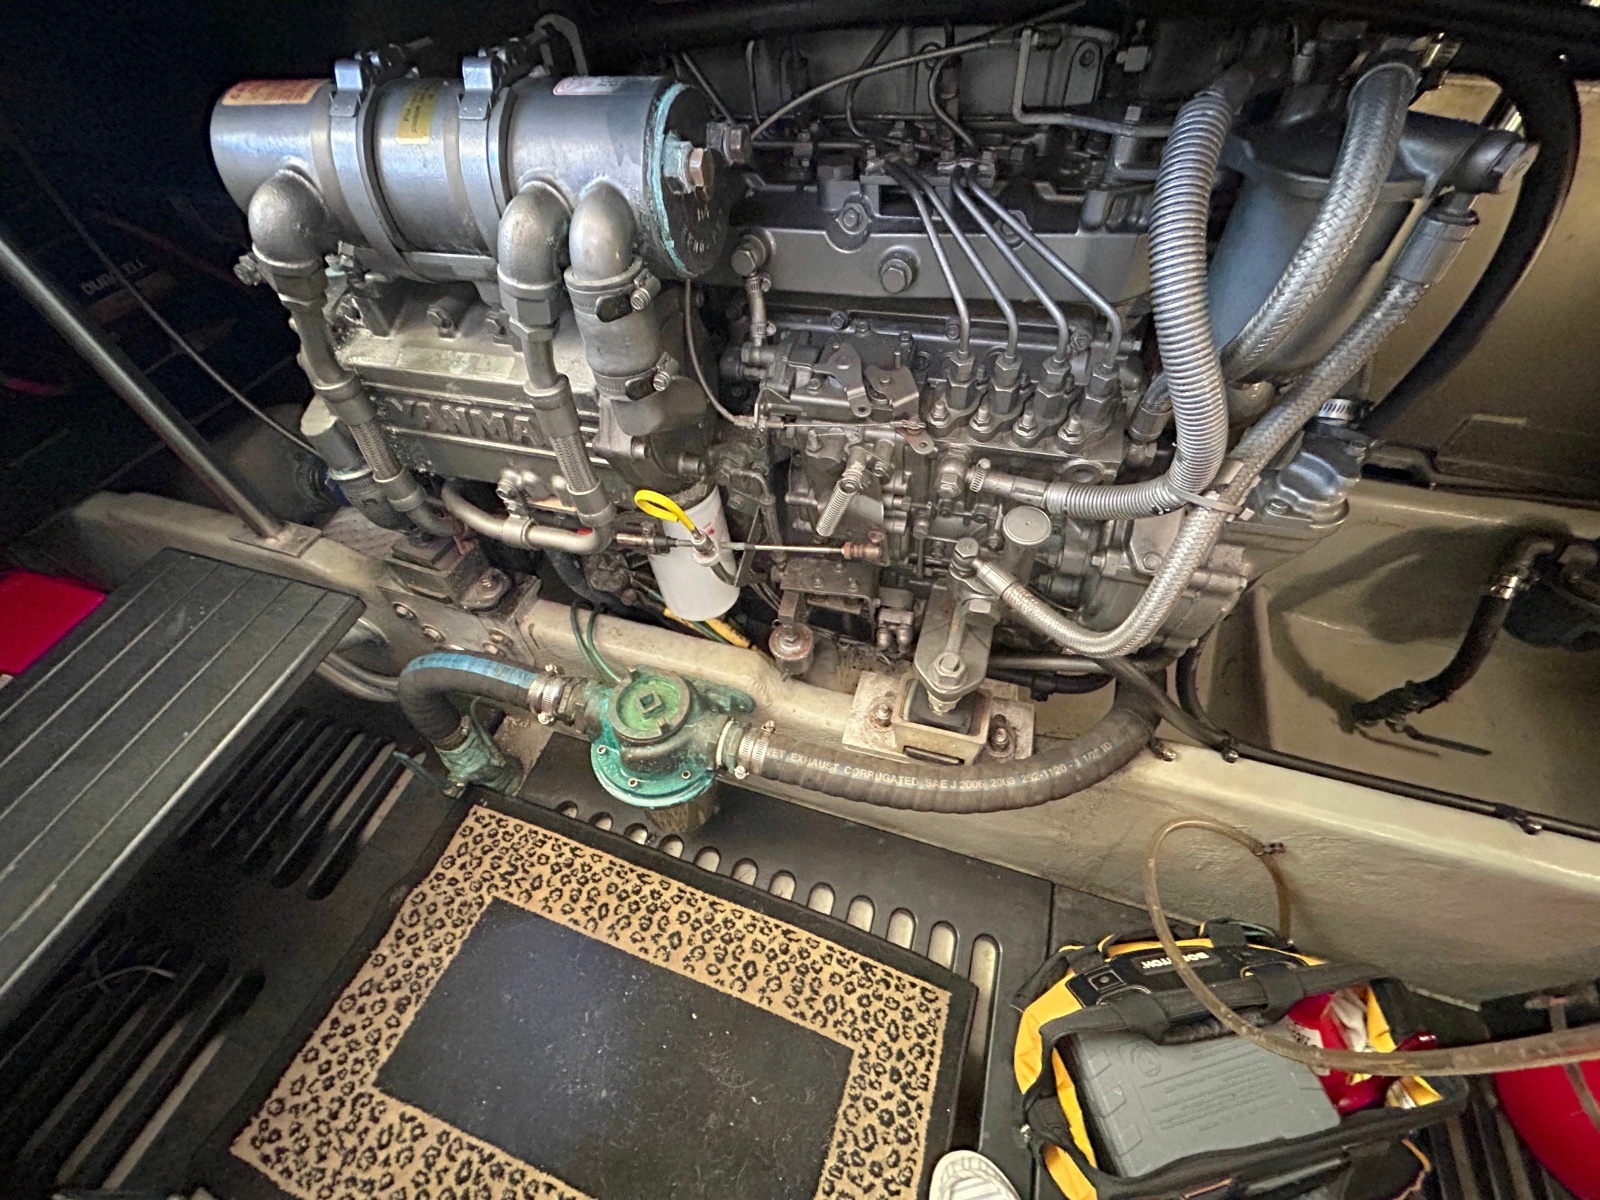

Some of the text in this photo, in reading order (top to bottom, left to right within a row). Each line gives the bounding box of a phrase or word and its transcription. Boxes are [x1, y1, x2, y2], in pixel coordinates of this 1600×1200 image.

[80, 257, 148, 296] DURAELL
[383, 396, 549, 451] YANMA
[789, 752, 839, 774] EXHAUST
[843, 766, 920, 787] CORRUGATED
[925, 778, 948, 789] SAE
